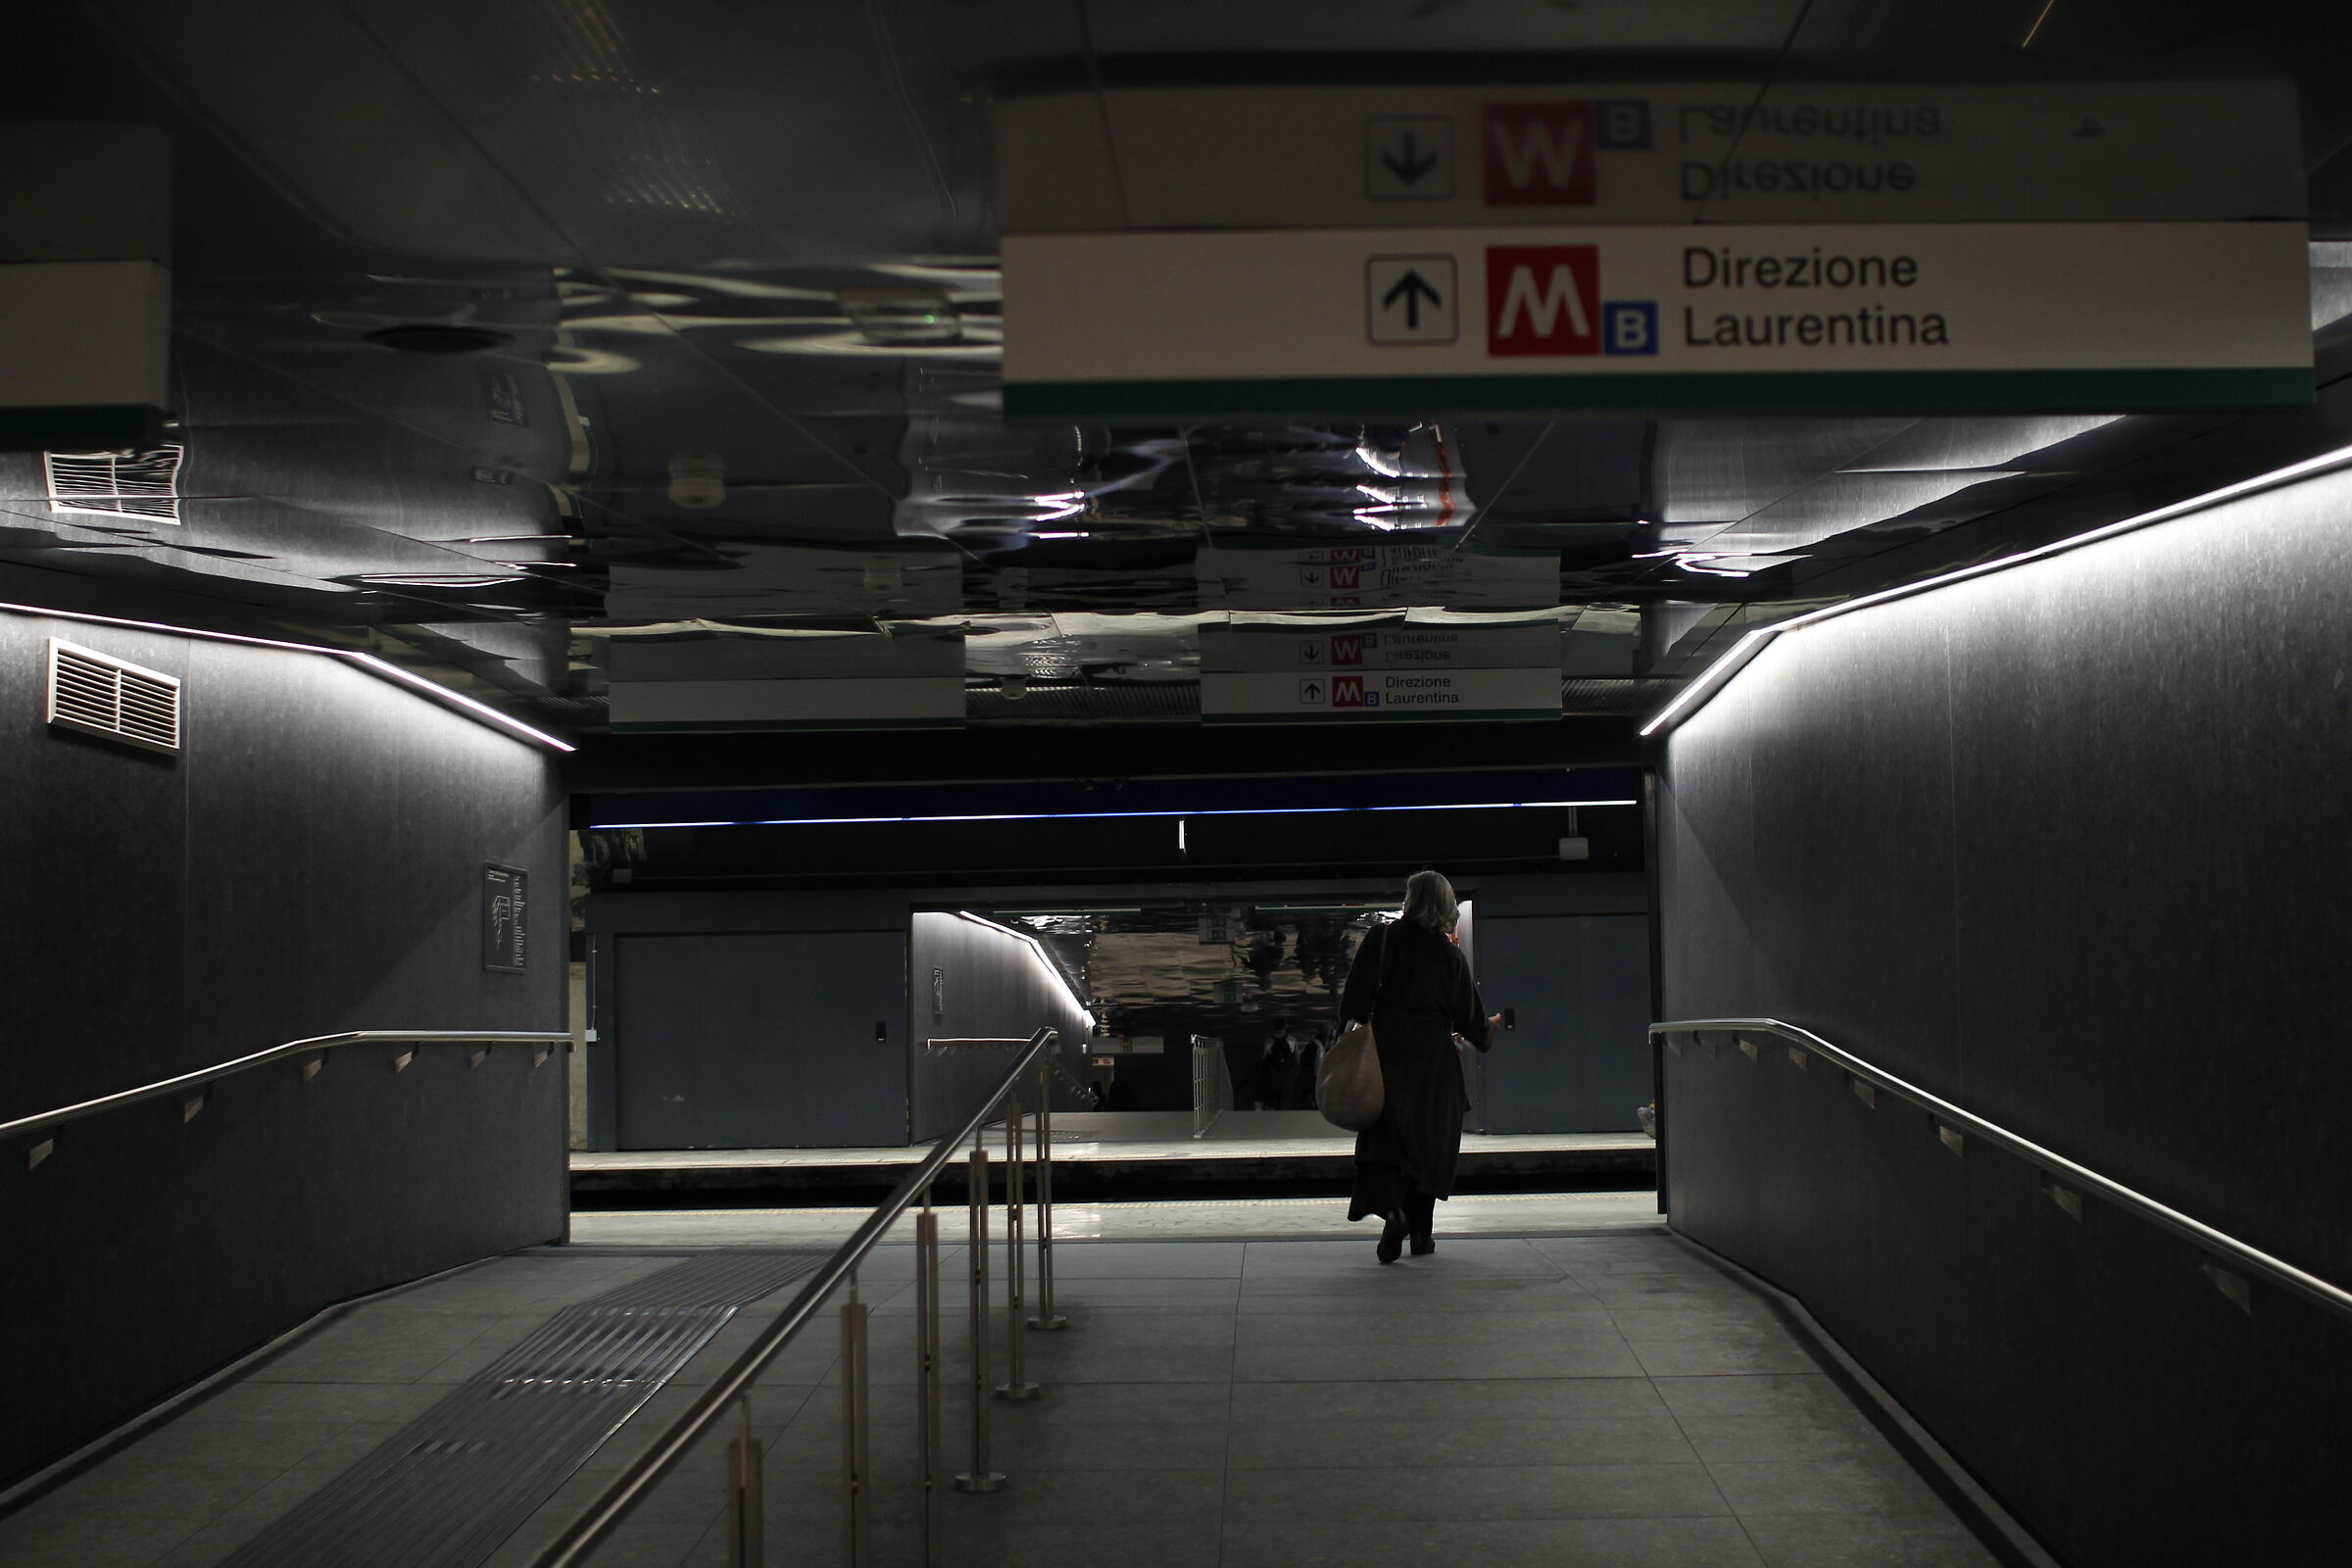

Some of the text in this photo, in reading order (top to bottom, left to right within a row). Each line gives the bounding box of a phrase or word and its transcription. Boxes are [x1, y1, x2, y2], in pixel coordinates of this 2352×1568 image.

[1684, 247, 1918, 288] Direzione
[1614, 309, 1650, 349] B
[1685, 304, 1950, 347] Laurentina
[1386, 676, 1450, 688] Direzione
[1386, 692, 1459, 704] Laurentina
